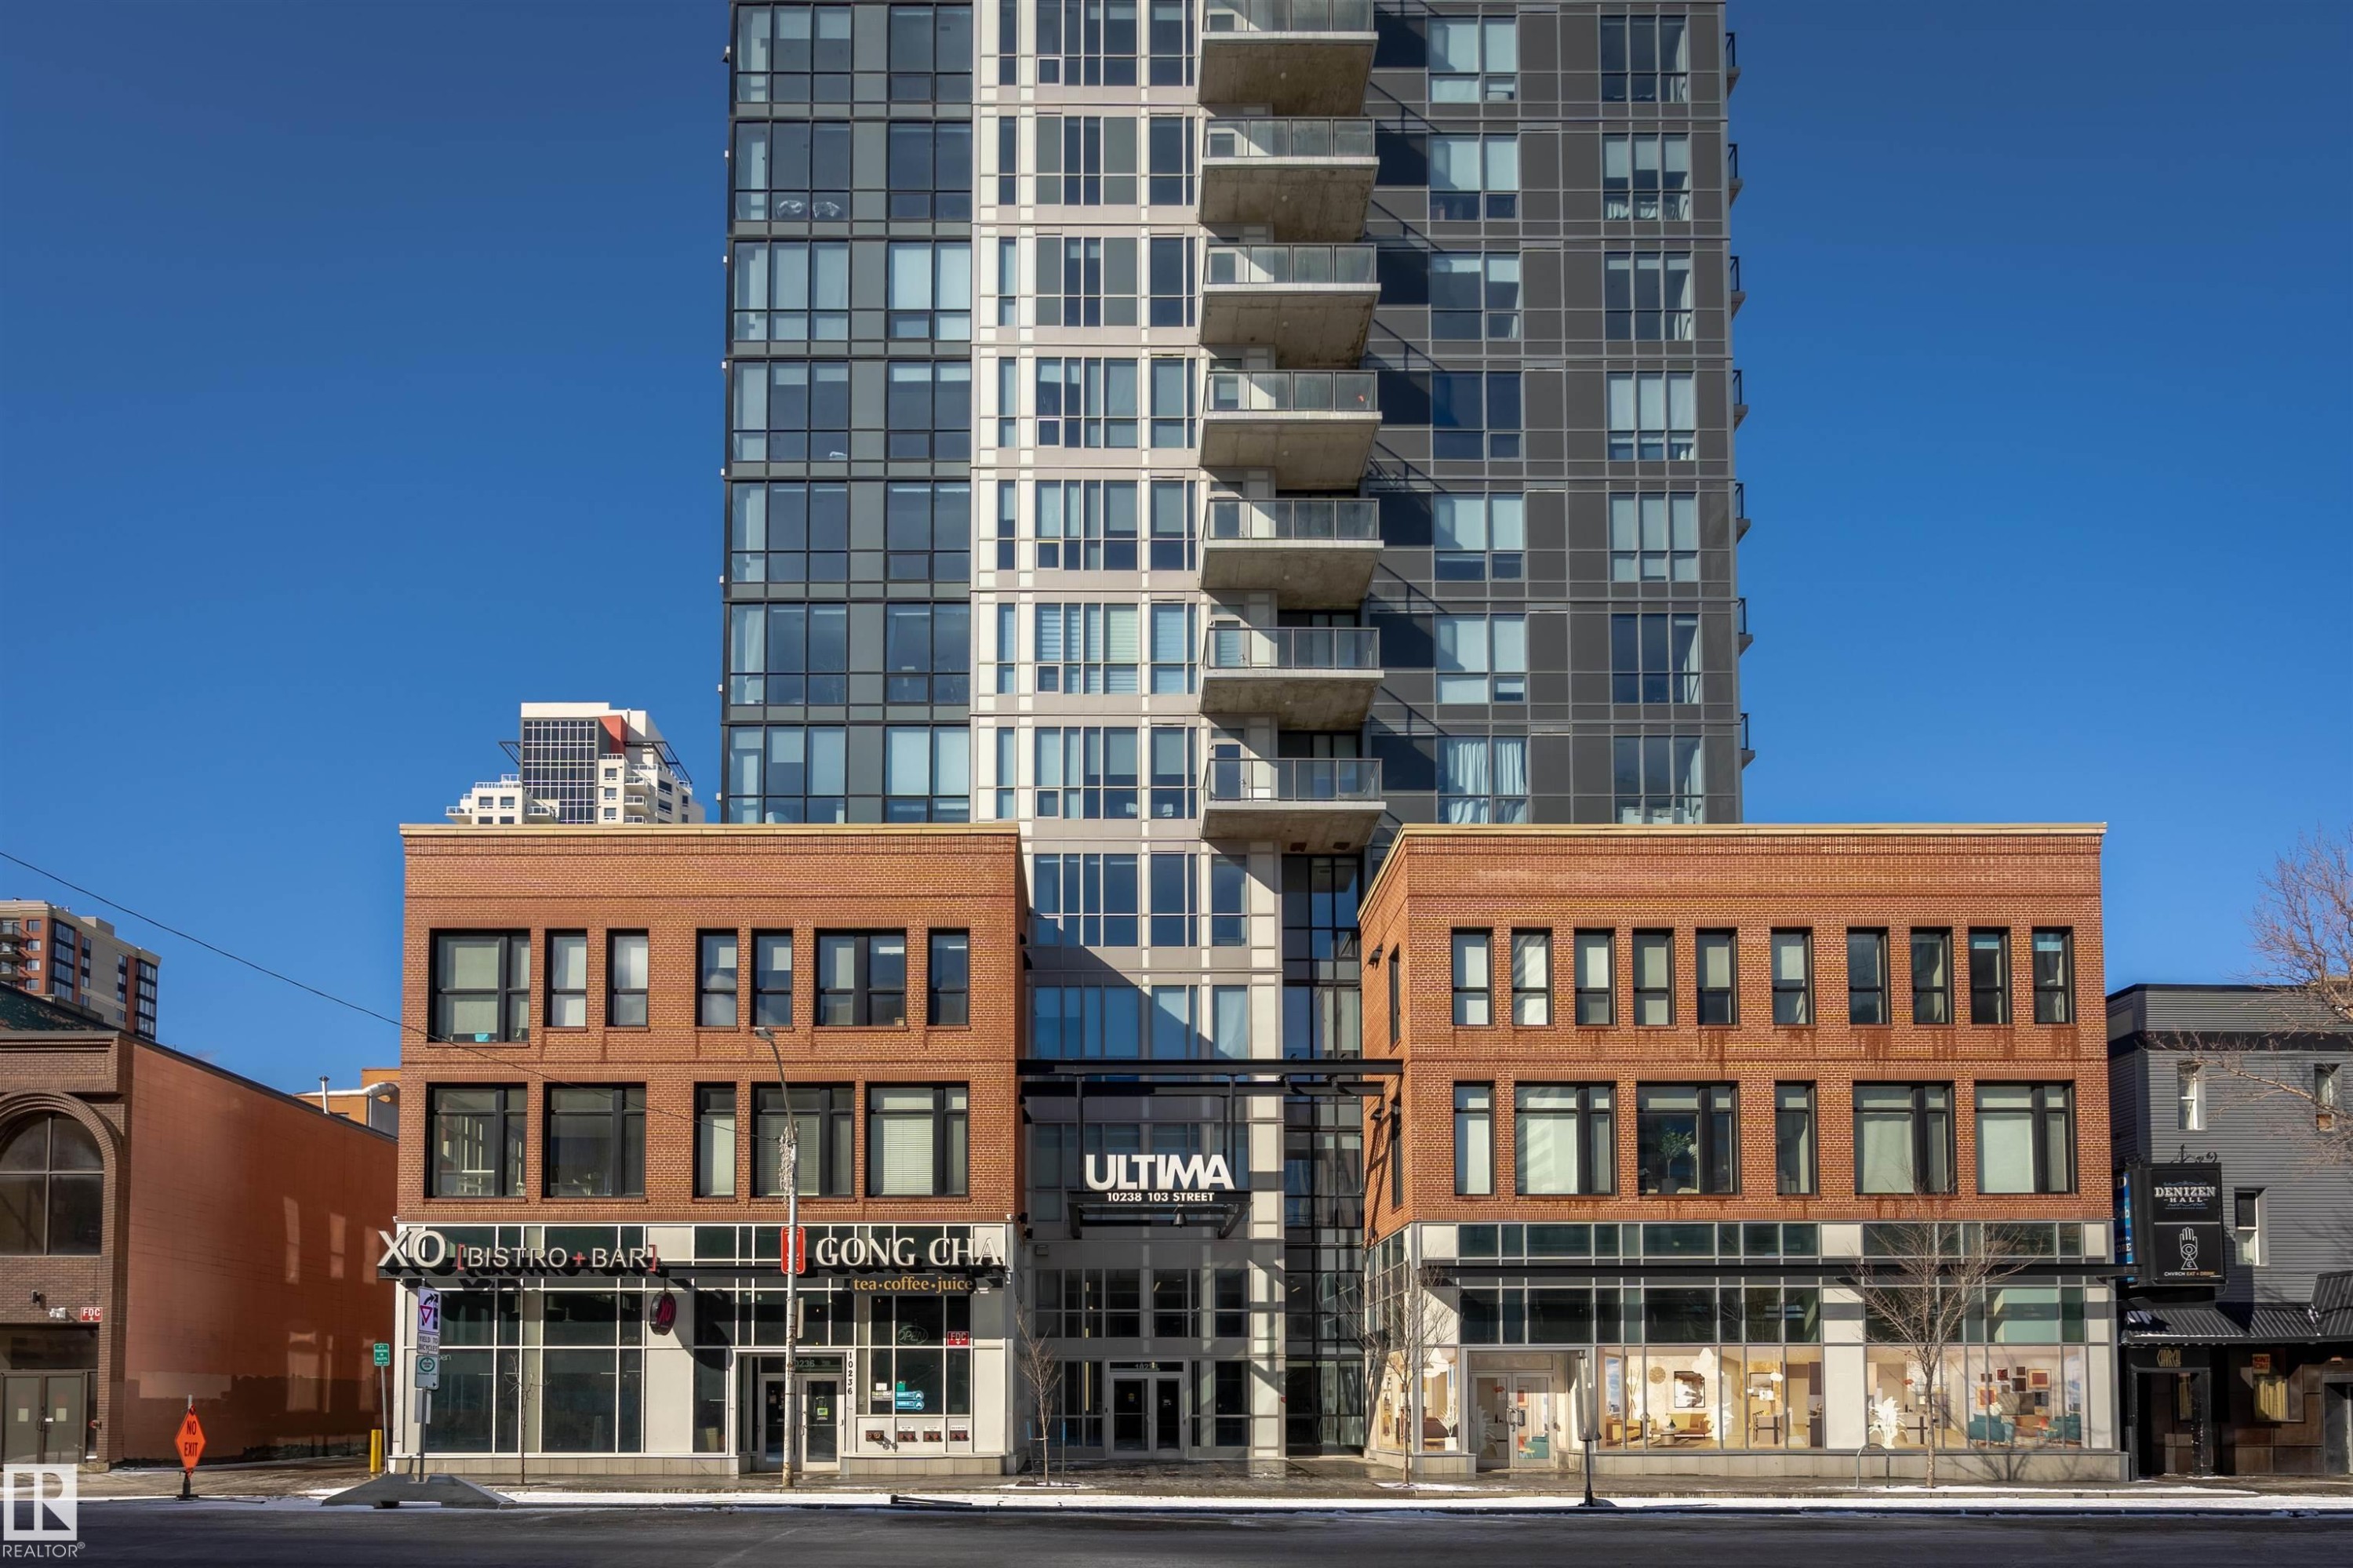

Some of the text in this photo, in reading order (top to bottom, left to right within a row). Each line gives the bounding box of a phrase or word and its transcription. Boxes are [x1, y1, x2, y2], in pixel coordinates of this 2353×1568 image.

[1086, 1154, 1235, 1191] ULTIMA
[1107, 1192, 1215, 1202] 10238 103 STREET
[2154, 1186, 2217, 1198] DENIZEN
[377, 1229, 446, 1268] XO
[815, 1237, 915, 1267] GONG
[928, 1236, 1002, 1267] CHA
[82, 1308, 100, 1317] FDC
[899, 1330, 926, 1342] OPEN
[950, 1332, 966, 1341] FDC
[418, 1344, 438, 1352] BICYCLES
[186, 1420, 197, 1436] NO
[184, 1442, 198, 1457] EXIT
